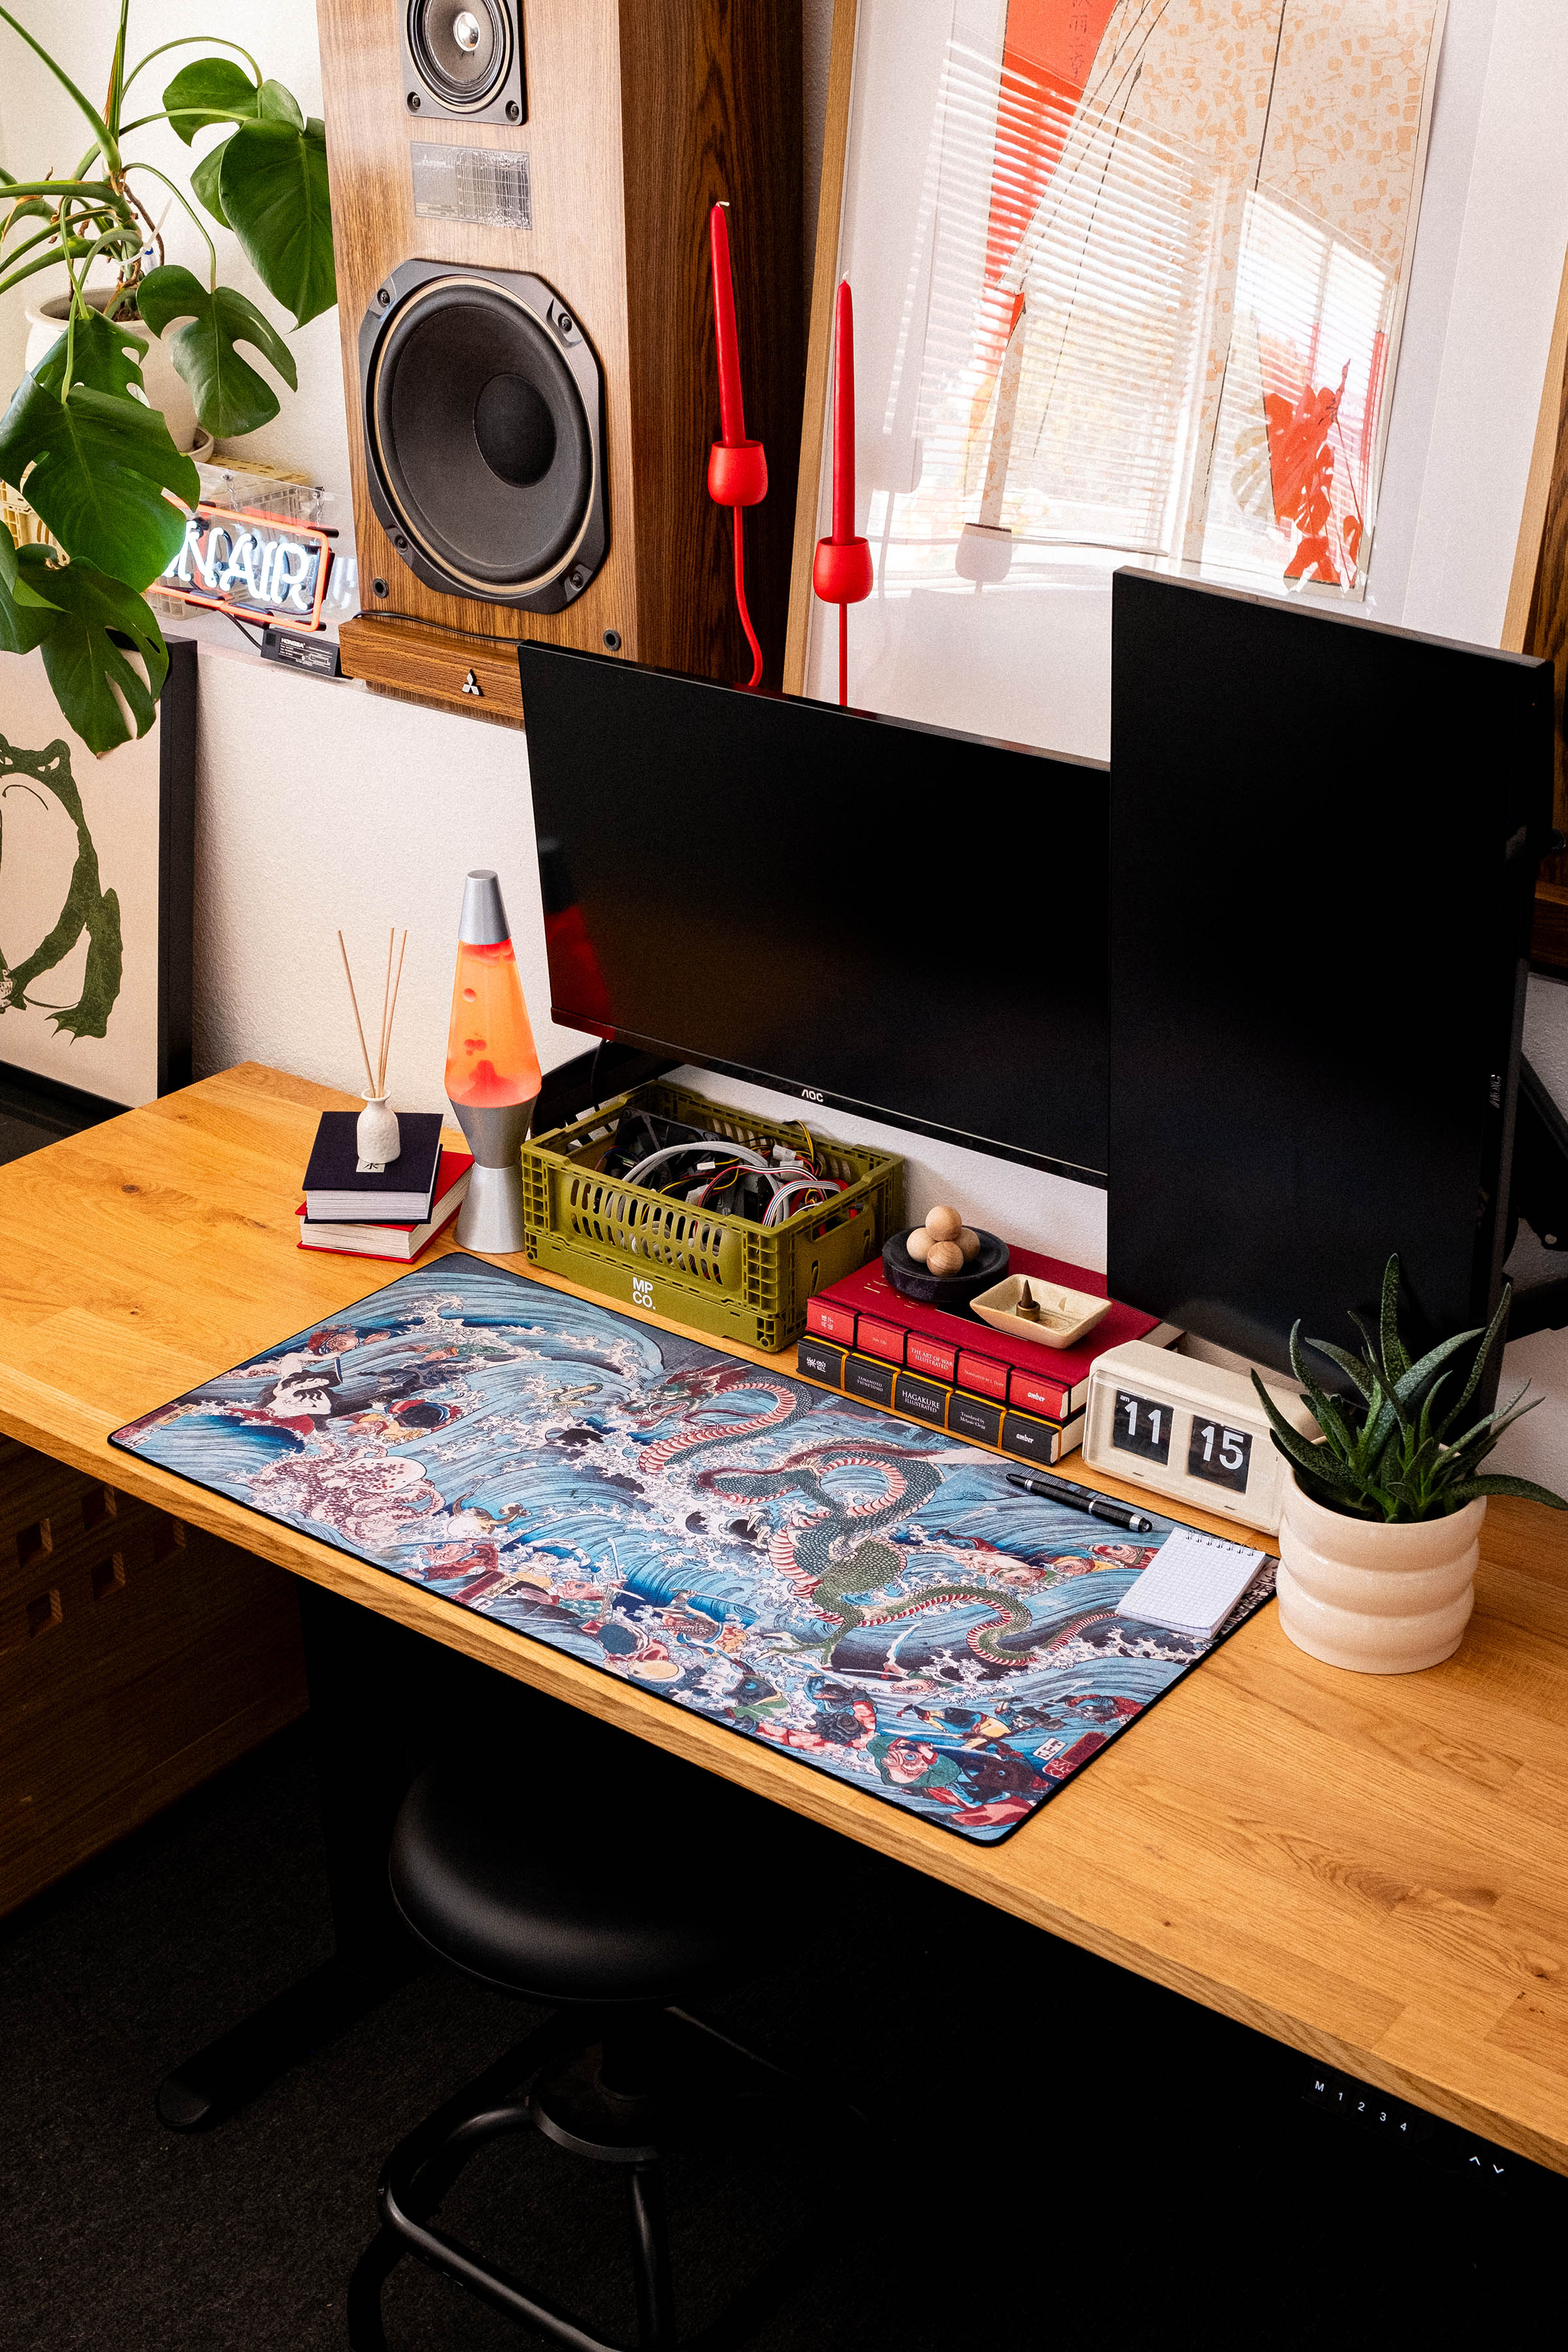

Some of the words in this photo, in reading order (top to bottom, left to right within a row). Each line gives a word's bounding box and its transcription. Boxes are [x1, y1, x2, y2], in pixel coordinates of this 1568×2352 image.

[220, 533, 309, 610] AIR
[801, 1089, 824, 1102] AOC
[632, 1277, 653, 1294] MP
[632, 1291, 656, 1310] CO.
[915, 1354, 949, 1370] ILLUSTRATED
[941, 1358, 953, 1367] WAR
[857, 1375, 883, 1388] YAMAMOTO
[857, 1379, 883, 1392] TSUNETOMO
[902, 1390, 940, 1409] HAGAKURE
[905, 1397, 938, 1413] ILLUSTRATED
[1027, 1392, 1045, 1402] amber
[1016, 1433, 1034, 1444] amber
[1124, 1401, 1162, 1445] 11
[1201, 1426, 1244, 1470] 15
[1315, 2080, 1324, 2092] M
[1338, 2092, 1343, 2101] 1
[1358, 2102, 1365, 2112] 2
[1379, 2112, 1386, 2121] 3
[1400, 2123, 1407, 2131] 4
